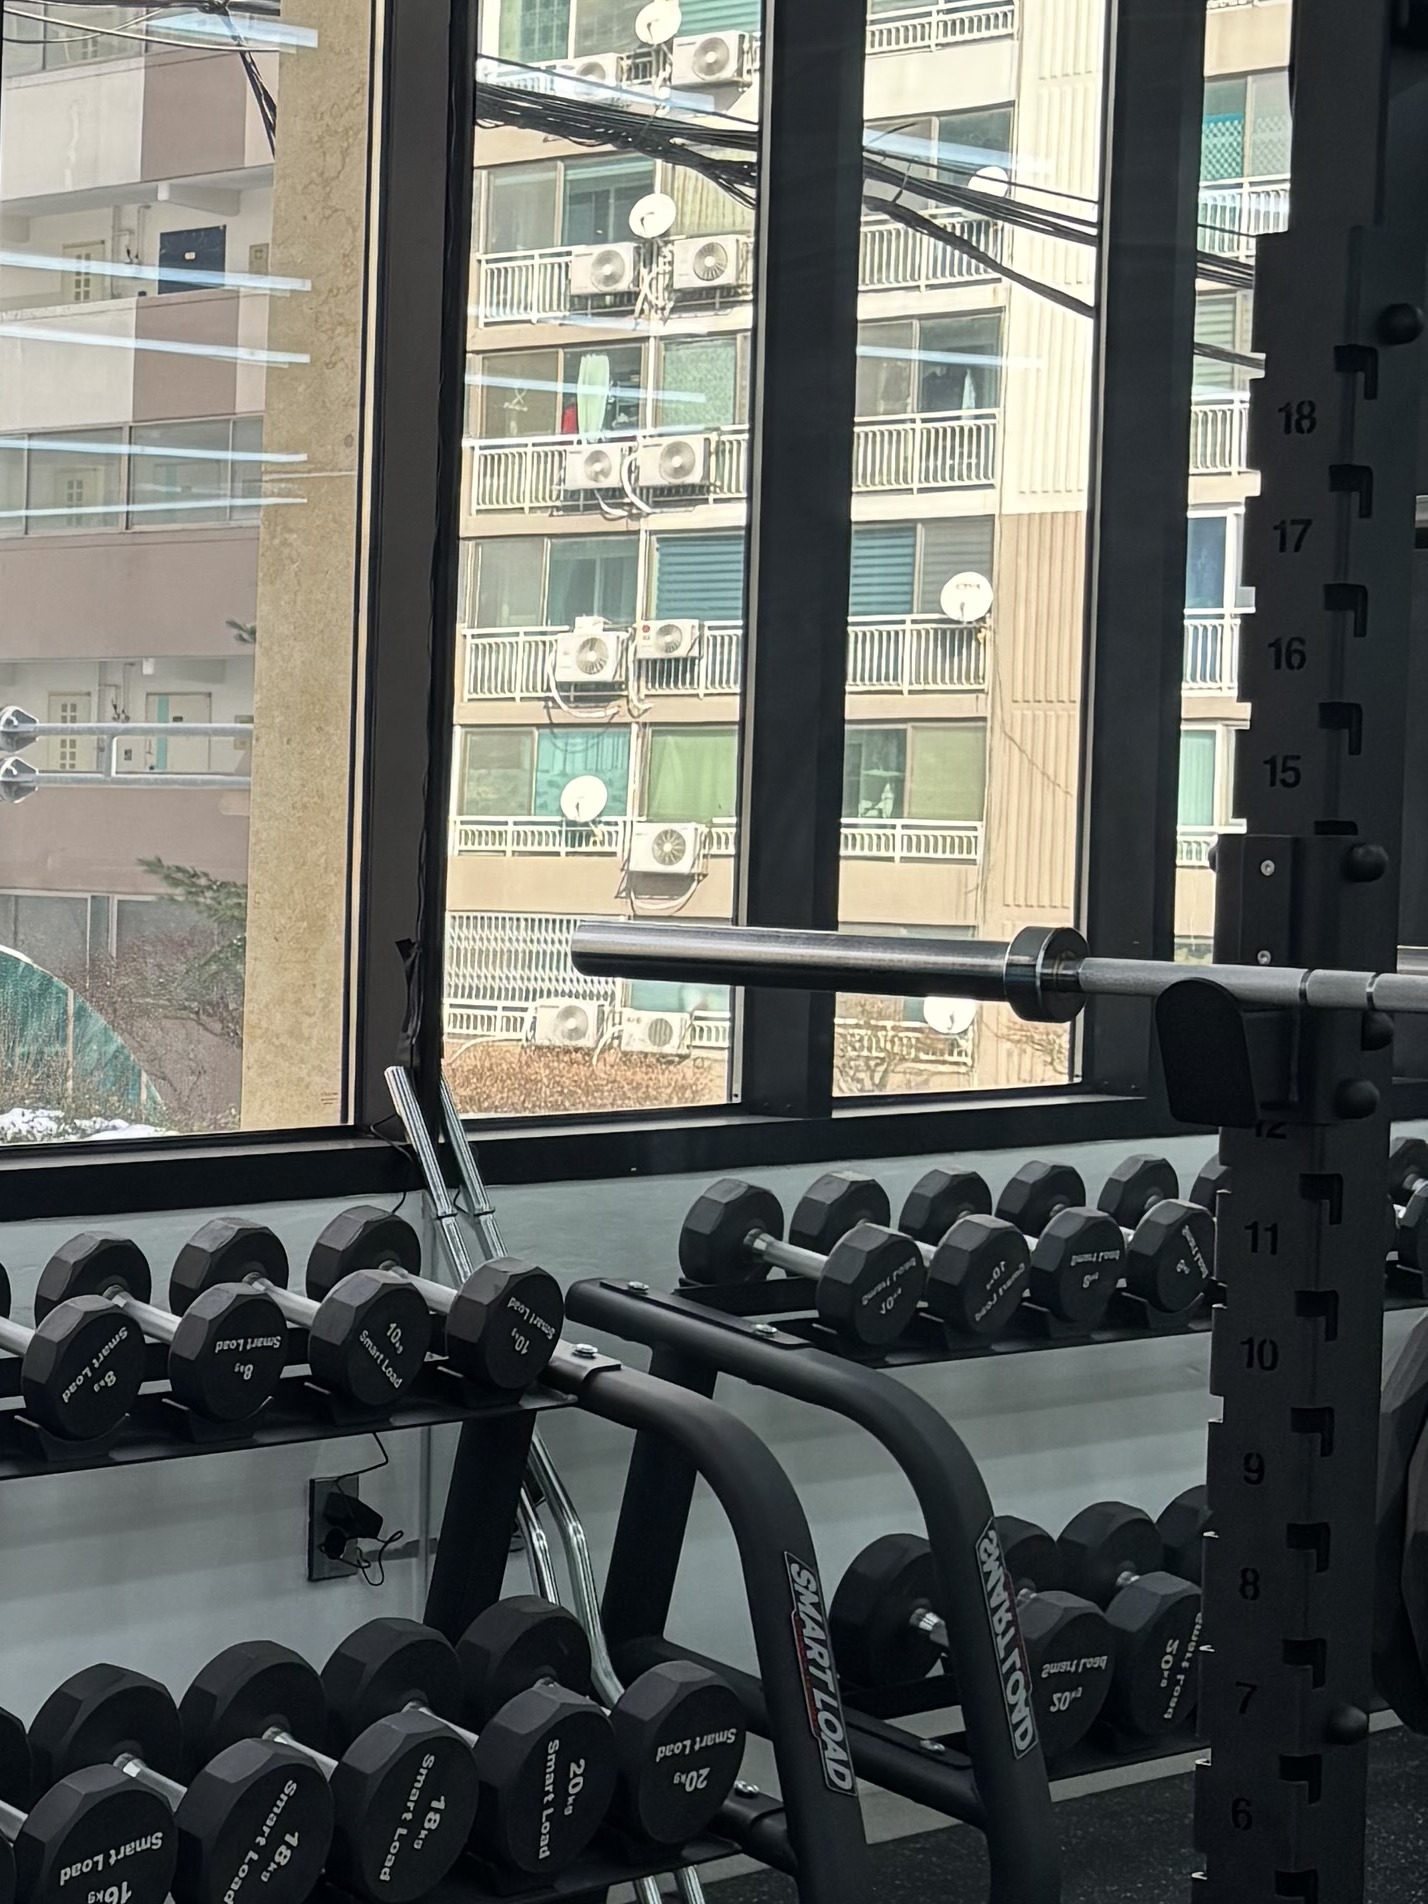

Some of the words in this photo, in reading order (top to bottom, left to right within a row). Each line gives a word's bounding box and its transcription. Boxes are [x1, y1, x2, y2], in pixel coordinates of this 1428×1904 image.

[1278, 401, 1317, 435] 18
[1271, 519, 1314, 552] 17
[1267, 637, 1307, 671] 16
[1263, 754, 1303, 789] 15
[1244, 1222, 1279, 1255] 11
[507, 1297, 535, 1320] Load
[529, 1313, 555, 1339] Smart
[92, 1327, 127, 1368] Smart
[215, 1339, 244, 1353] Load
[247, 1336, 281, 1350] Smart
[387, 1323, 403, 1353] 10kg
[1240, 1337, 1279, 1371] 10
[360, 1330, 388, 1364] Smart
[382, 1359, 402, 1388] Load
[62, 1367, 92, 1402] Load
[1243, 1451, 1265, 1486] 9
[1239, 1567, 1261, 1601] 8
[791, 1562, 838, 1692] SMART
[1235, 1681, 1258, 1716] 7
[656, 1740, 696, 1762] Load
[695, 1729, 736, 1751] Smart
[813, 1687, 853, 1790] LOAD
[402, 1754, 434, 1820] Smart
[544, 1740, 559, 1810] Smart
[564, 1759, 585, 1815] 20kg
[674, 1768, 710, 1791] 20kg
[256, 1780, 296, 1845] Smart
[414, 1797, 445, 1849] 18kg
[1230, 1796, 1253, 1831] 6
[110, 1832, 163, 1865] Smart
[539, 1809, 553, 1859] Load
[60, 1854, 103, 1885] Load
[261, 1832, 298, 1881] 18kg
[380, 1828, 407, 1881] Load
[224, 1851, 258, 1904] Load
